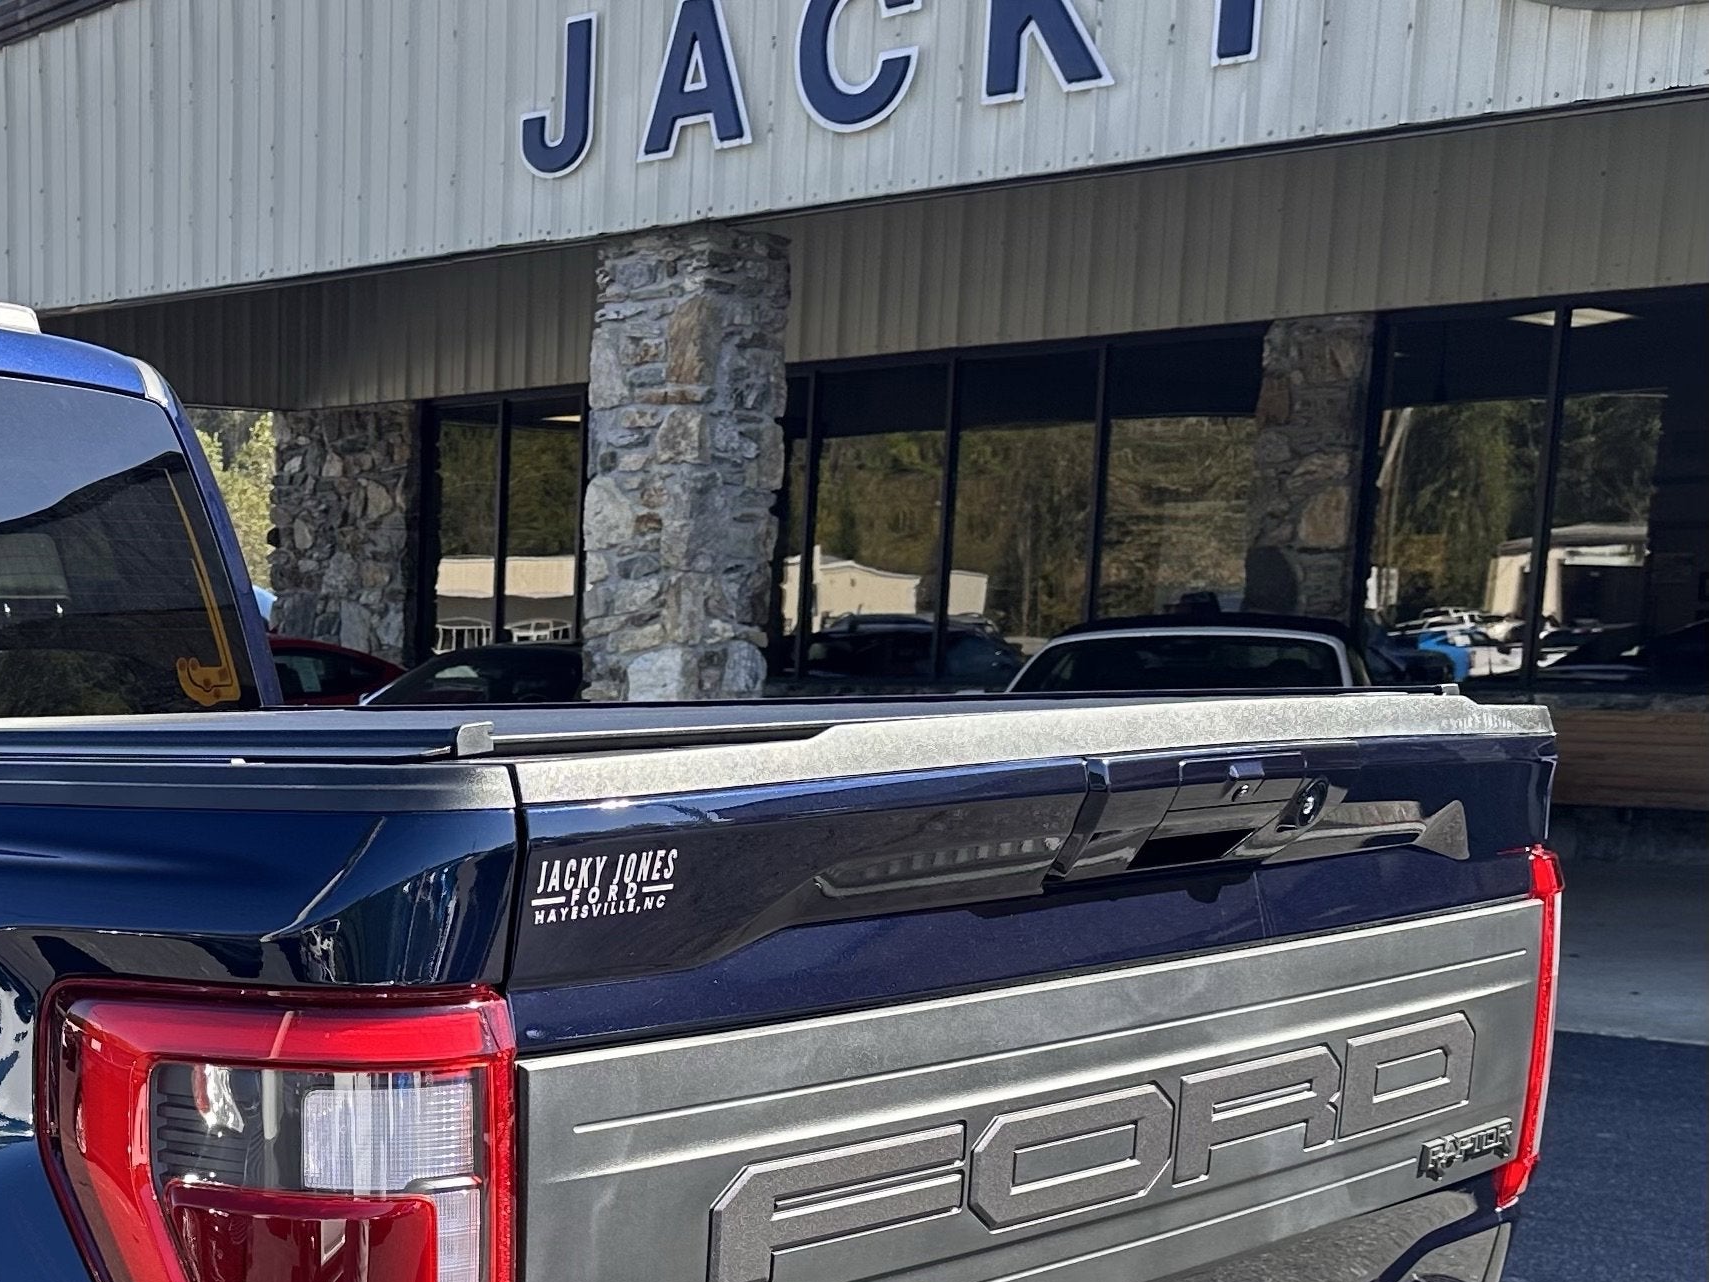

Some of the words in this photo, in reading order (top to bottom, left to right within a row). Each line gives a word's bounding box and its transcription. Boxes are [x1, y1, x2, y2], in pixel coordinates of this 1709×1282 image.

[536, 856, 608, 894] JACKY
[612, 848, 678, 886] JONES
[570, 881, 638, 907] FORD
[1416, 1116, 1513, 1182] RAPTOR
